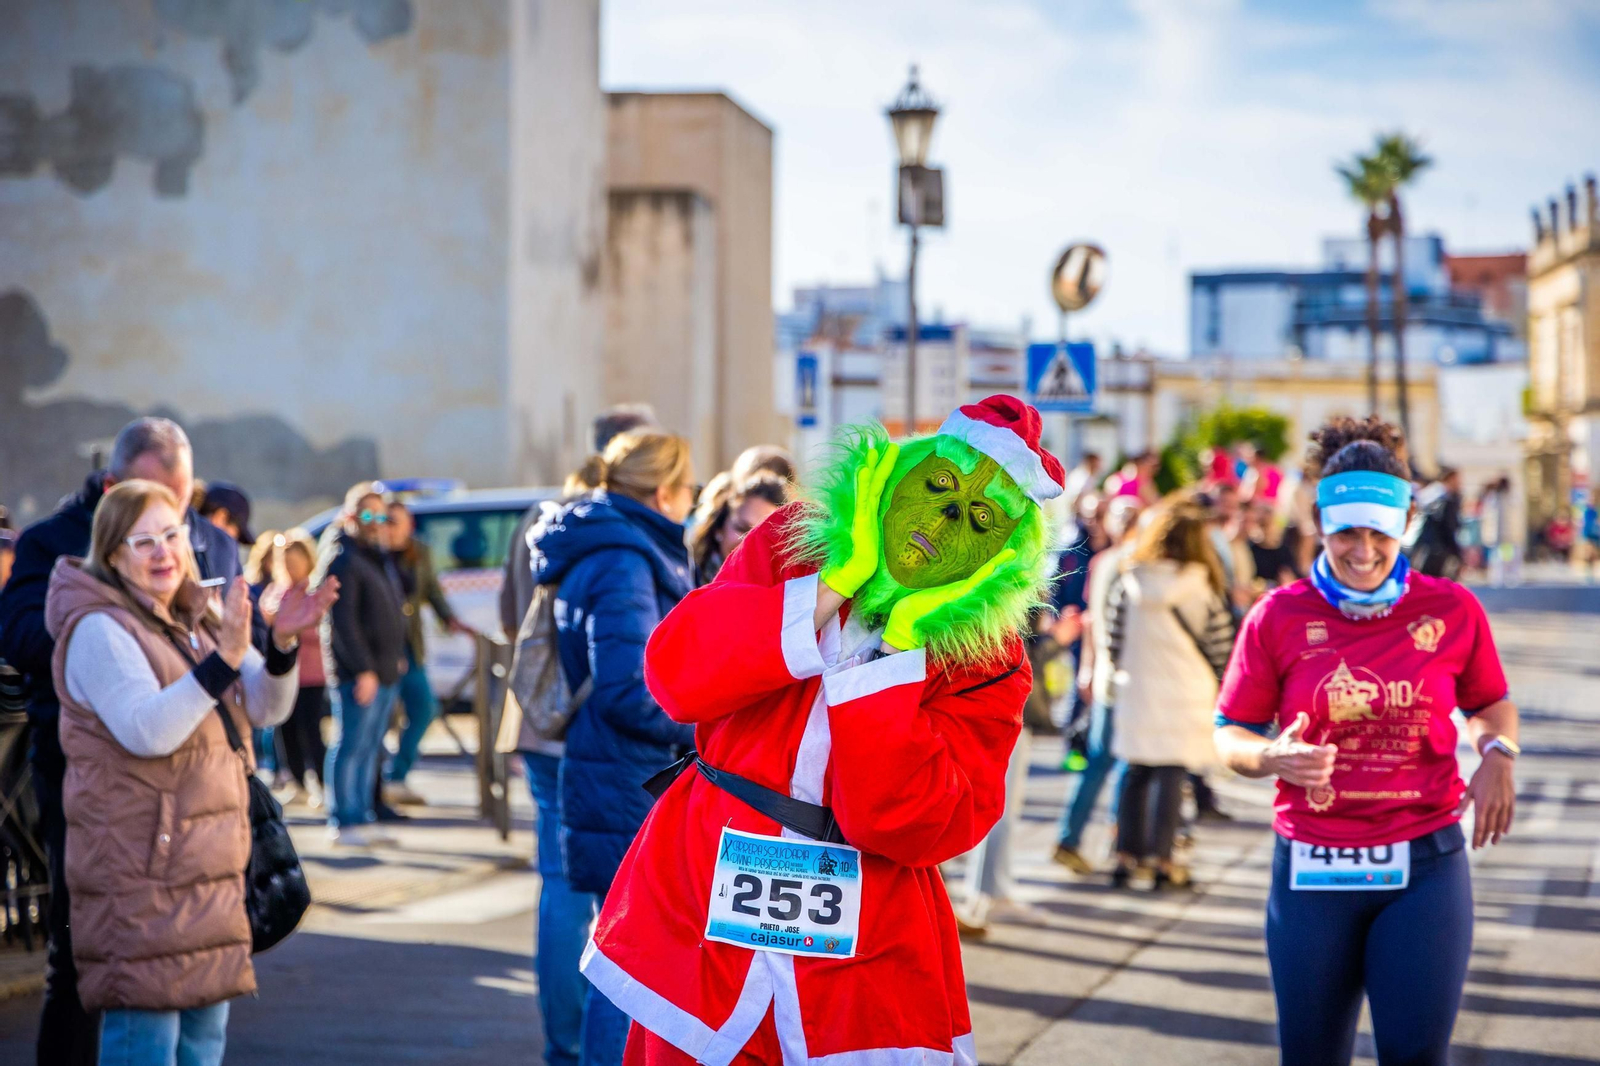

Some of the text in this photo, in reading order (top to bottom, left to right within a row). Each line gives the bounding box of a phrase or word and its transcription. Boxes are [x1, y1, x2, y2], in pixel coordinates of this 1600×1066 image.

[730, 852, 751, 866] DIVINA
[733, 840, 810, 861] CARRERA SOLIDARIA
[1310, 845, 1393, 865] 440
[732, 873, 843, 925] 253
[760, 922, 780, 932] PRIETO
[784, 925, 800, 934] JOSE
[750, 931, 802, 946] cajasur
